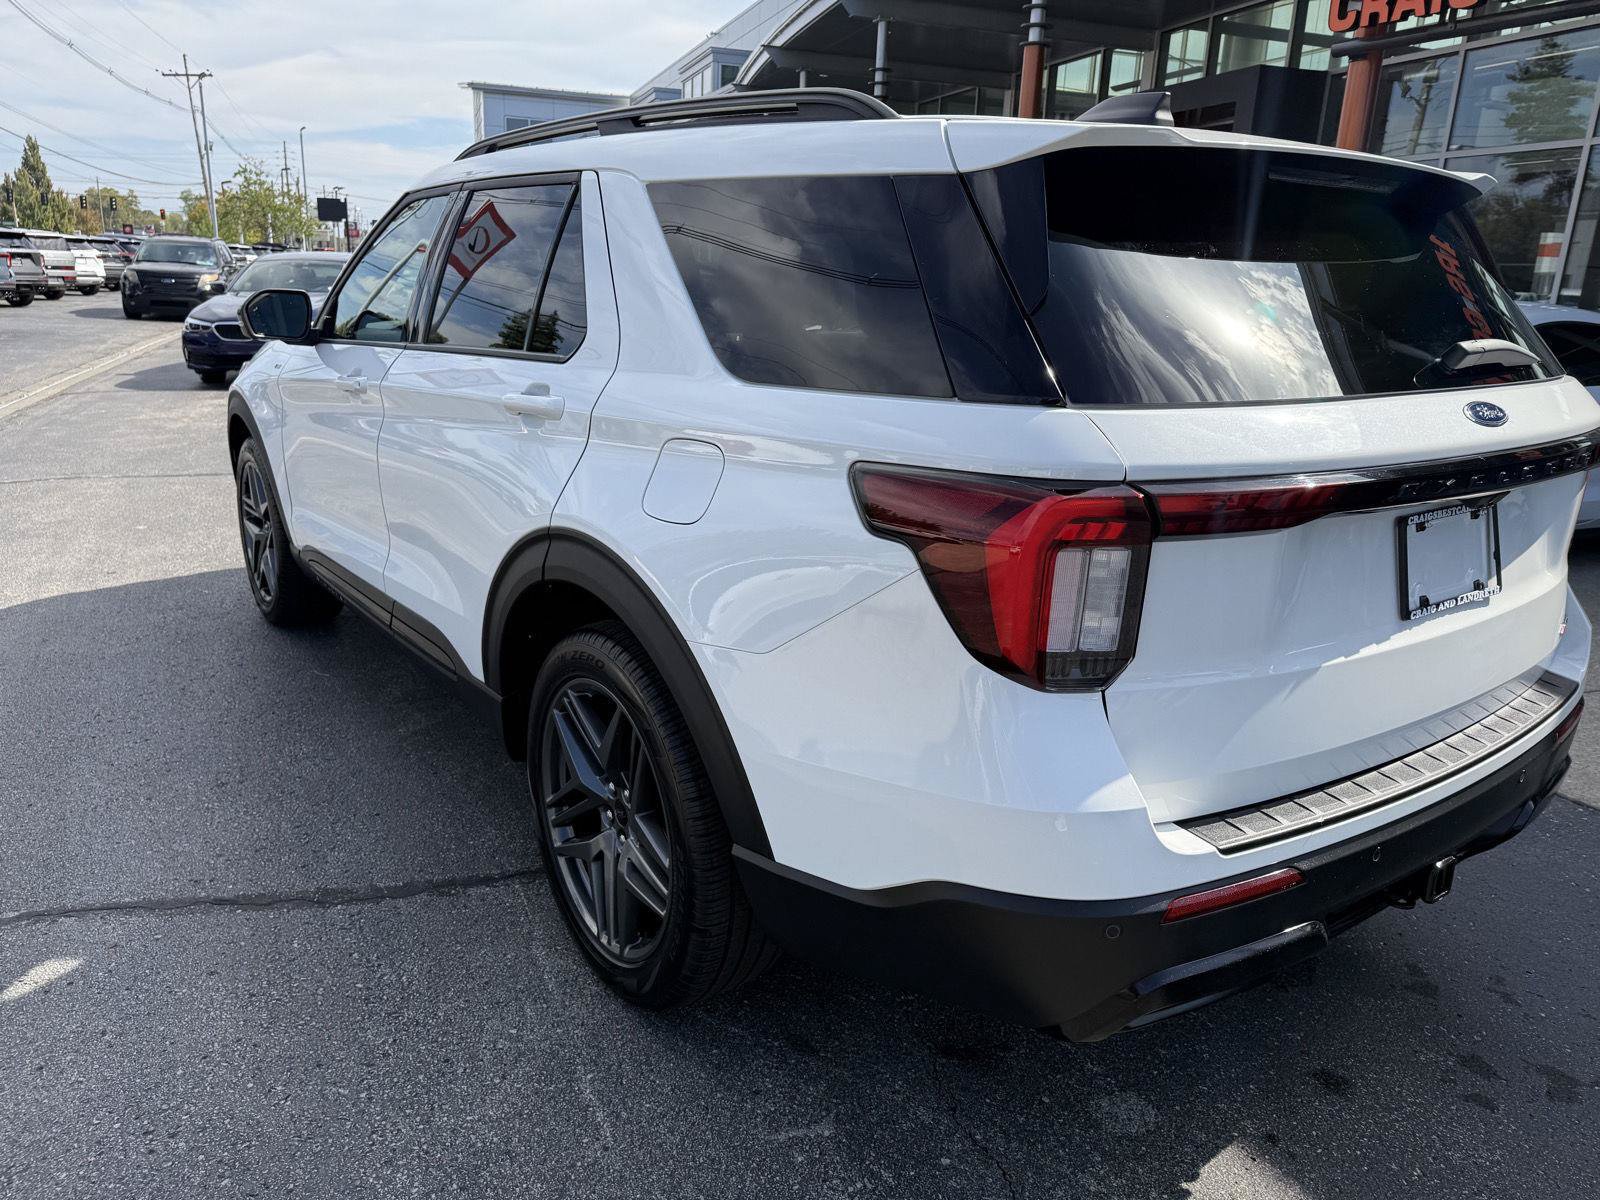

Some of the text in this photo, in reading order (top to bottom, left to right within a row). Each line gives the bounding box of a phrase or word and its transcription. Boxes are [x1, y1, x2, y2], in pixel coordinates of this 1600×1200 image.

[1328, 0, 1479, 32] CRA
[1410, 605, 1437, 620] CRAIG
[1437, 599, 1457, 612] AND
